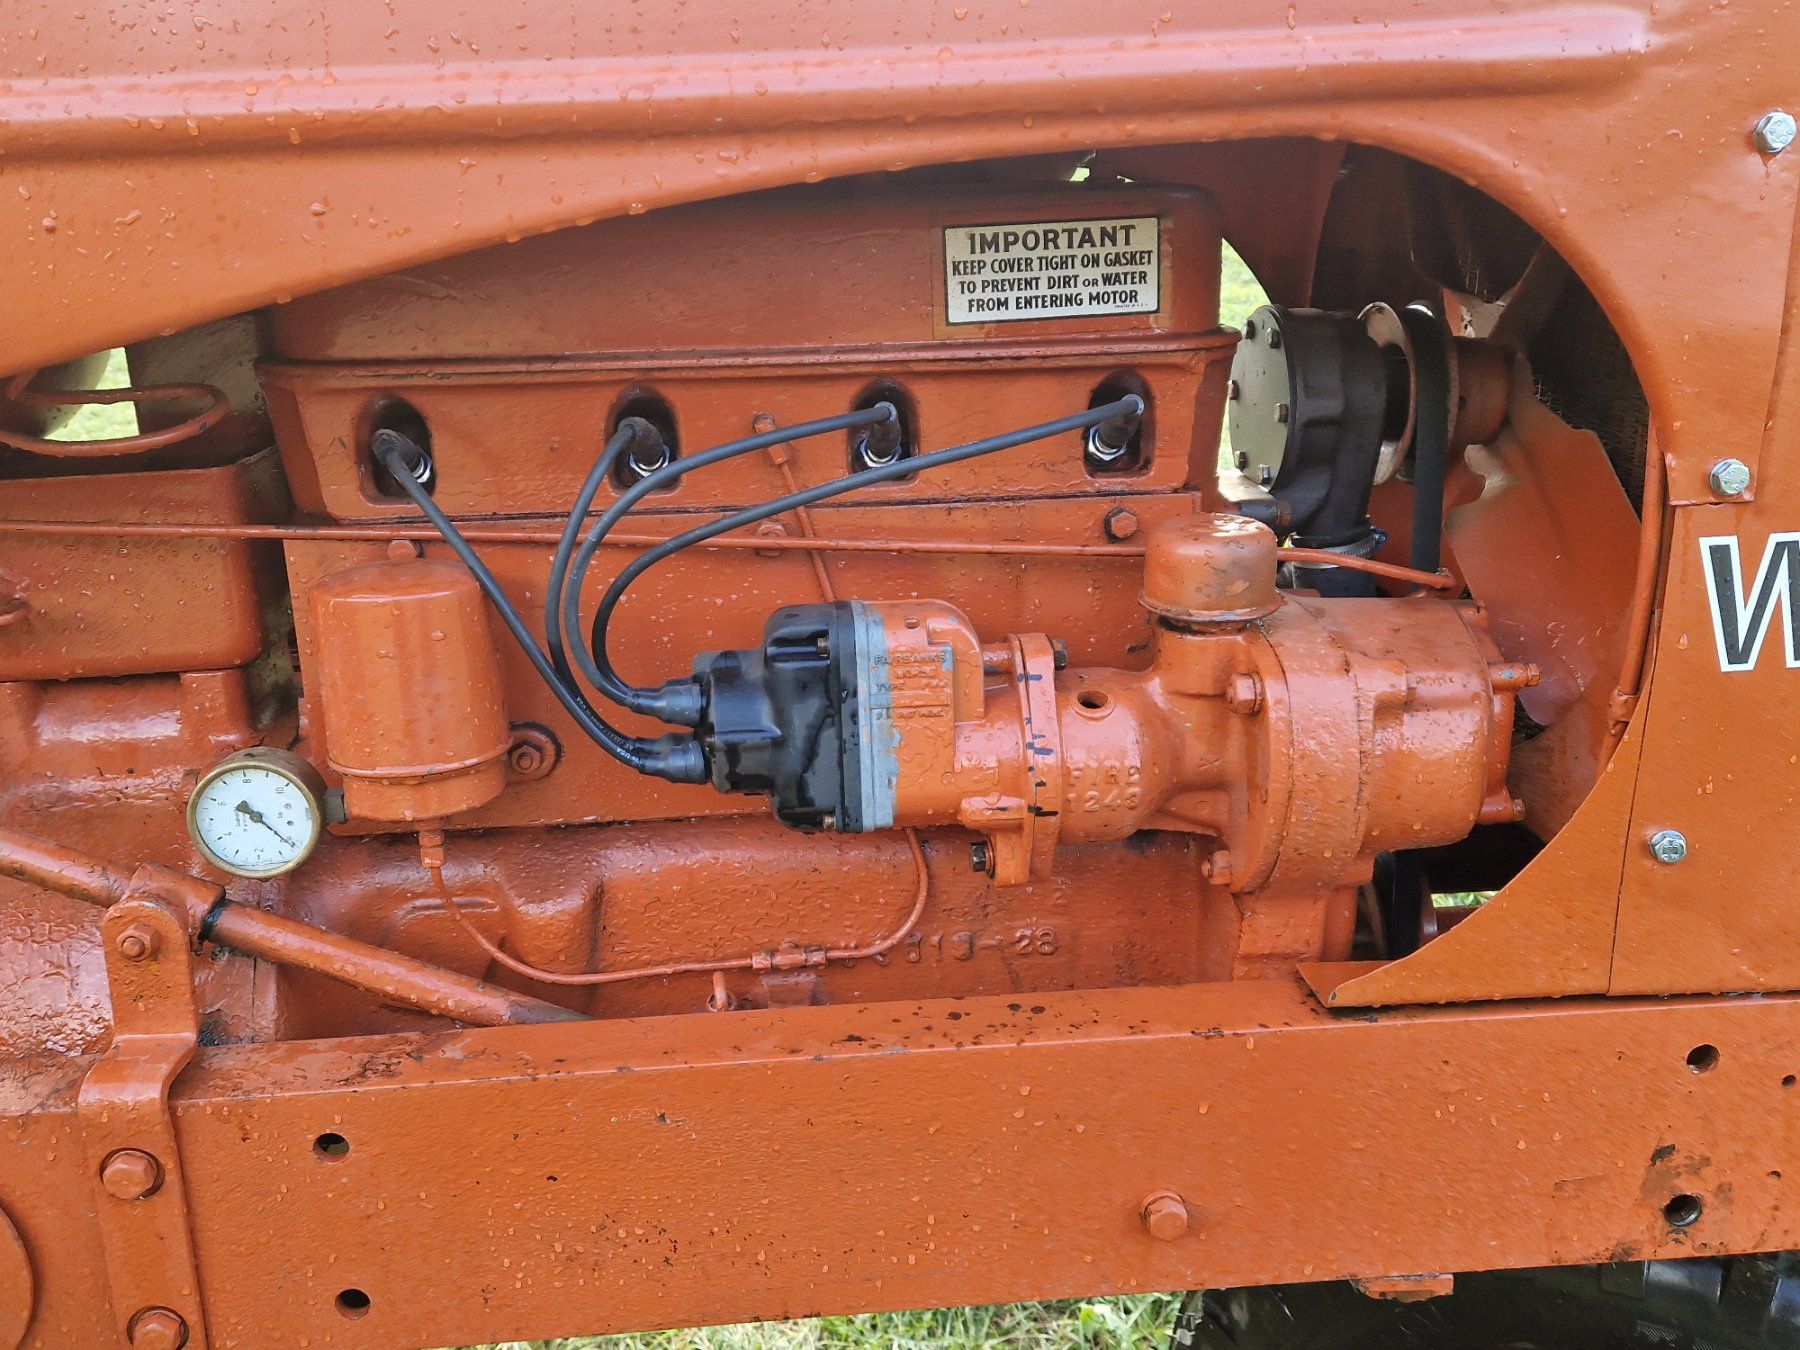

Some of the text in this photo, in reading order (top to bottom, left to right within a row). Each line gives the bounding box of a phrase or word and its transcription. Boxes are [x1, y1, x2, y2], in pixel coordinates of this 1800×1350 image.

[968, 224, 1137, 255] IMPORTANT
[952, 250, 1154, 276] KEEP COVER TIGHT ON GASKET
[959, 280, 977, 294] TO
[981, 276, 1041, 293] PREVENT
[1047, 275, 1080, 290] DIRT
[1101, 271, 1148, 286] WATER
[968, 297, 1009, 313] FROM
[1015, 293, 1084, 310] ENTERING
[1088, 289, 1138, 307] MOTOR
